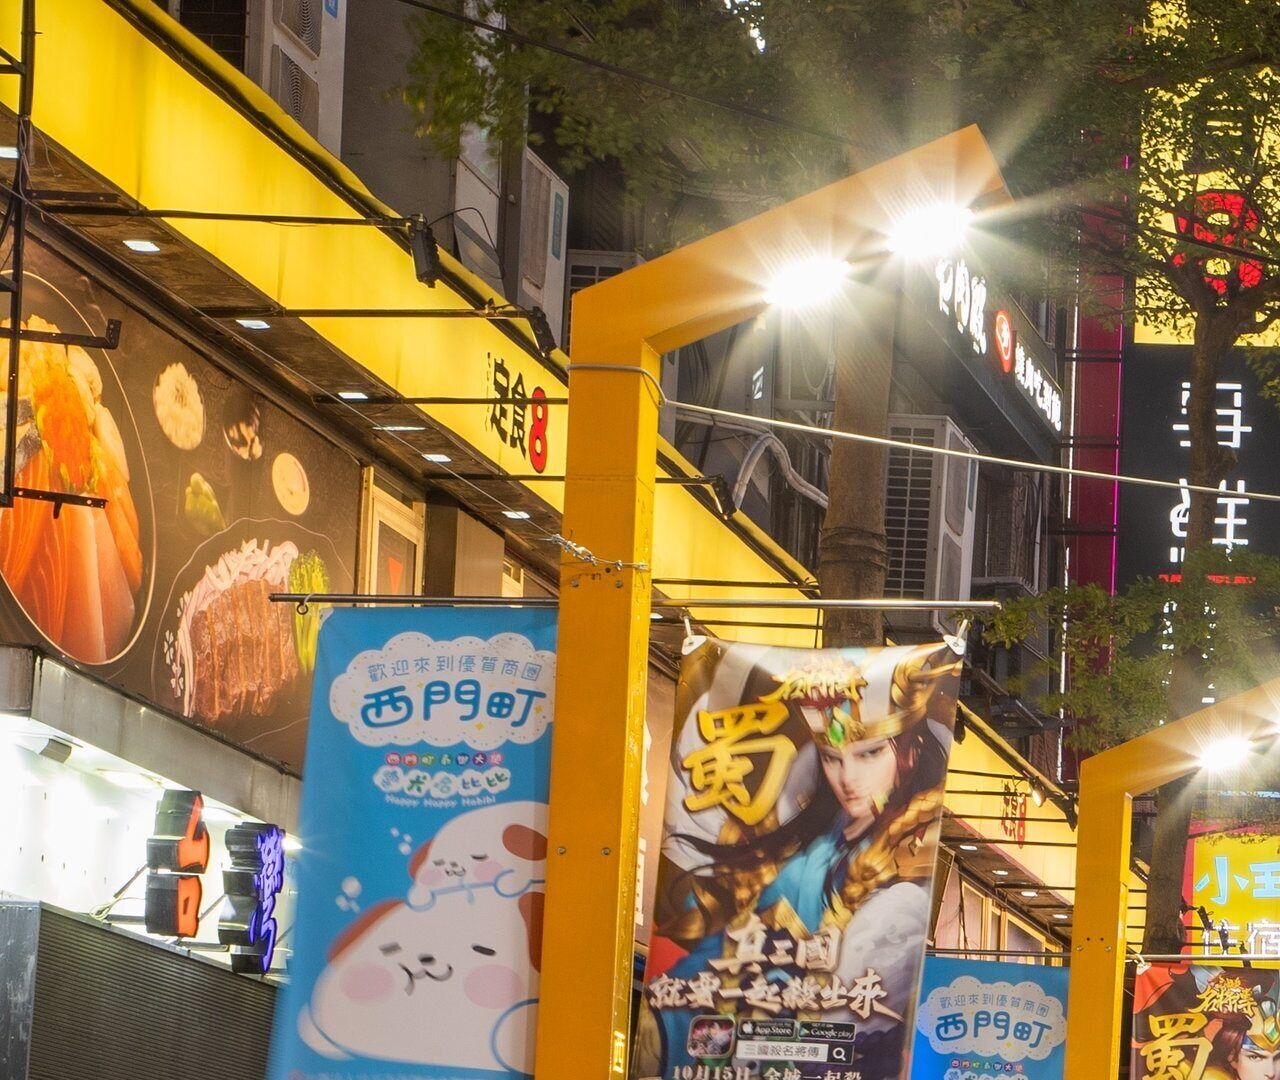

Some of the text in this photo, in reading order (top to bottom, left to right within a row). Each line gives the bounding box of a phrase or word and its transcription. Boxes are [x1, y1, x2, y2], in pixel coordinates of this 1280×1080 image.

[369, 655, 542, 682] 歡迎來到優質商圈
[361, 679, 547, 728] 西門町
[683, 701, 798, 826] 蜀
[707, 912, 843, 975] 真三國
[939, 994, 1050, 1018] 歡迎來到優質商圈
[935, 1011, 1052, 1048] 西門町
